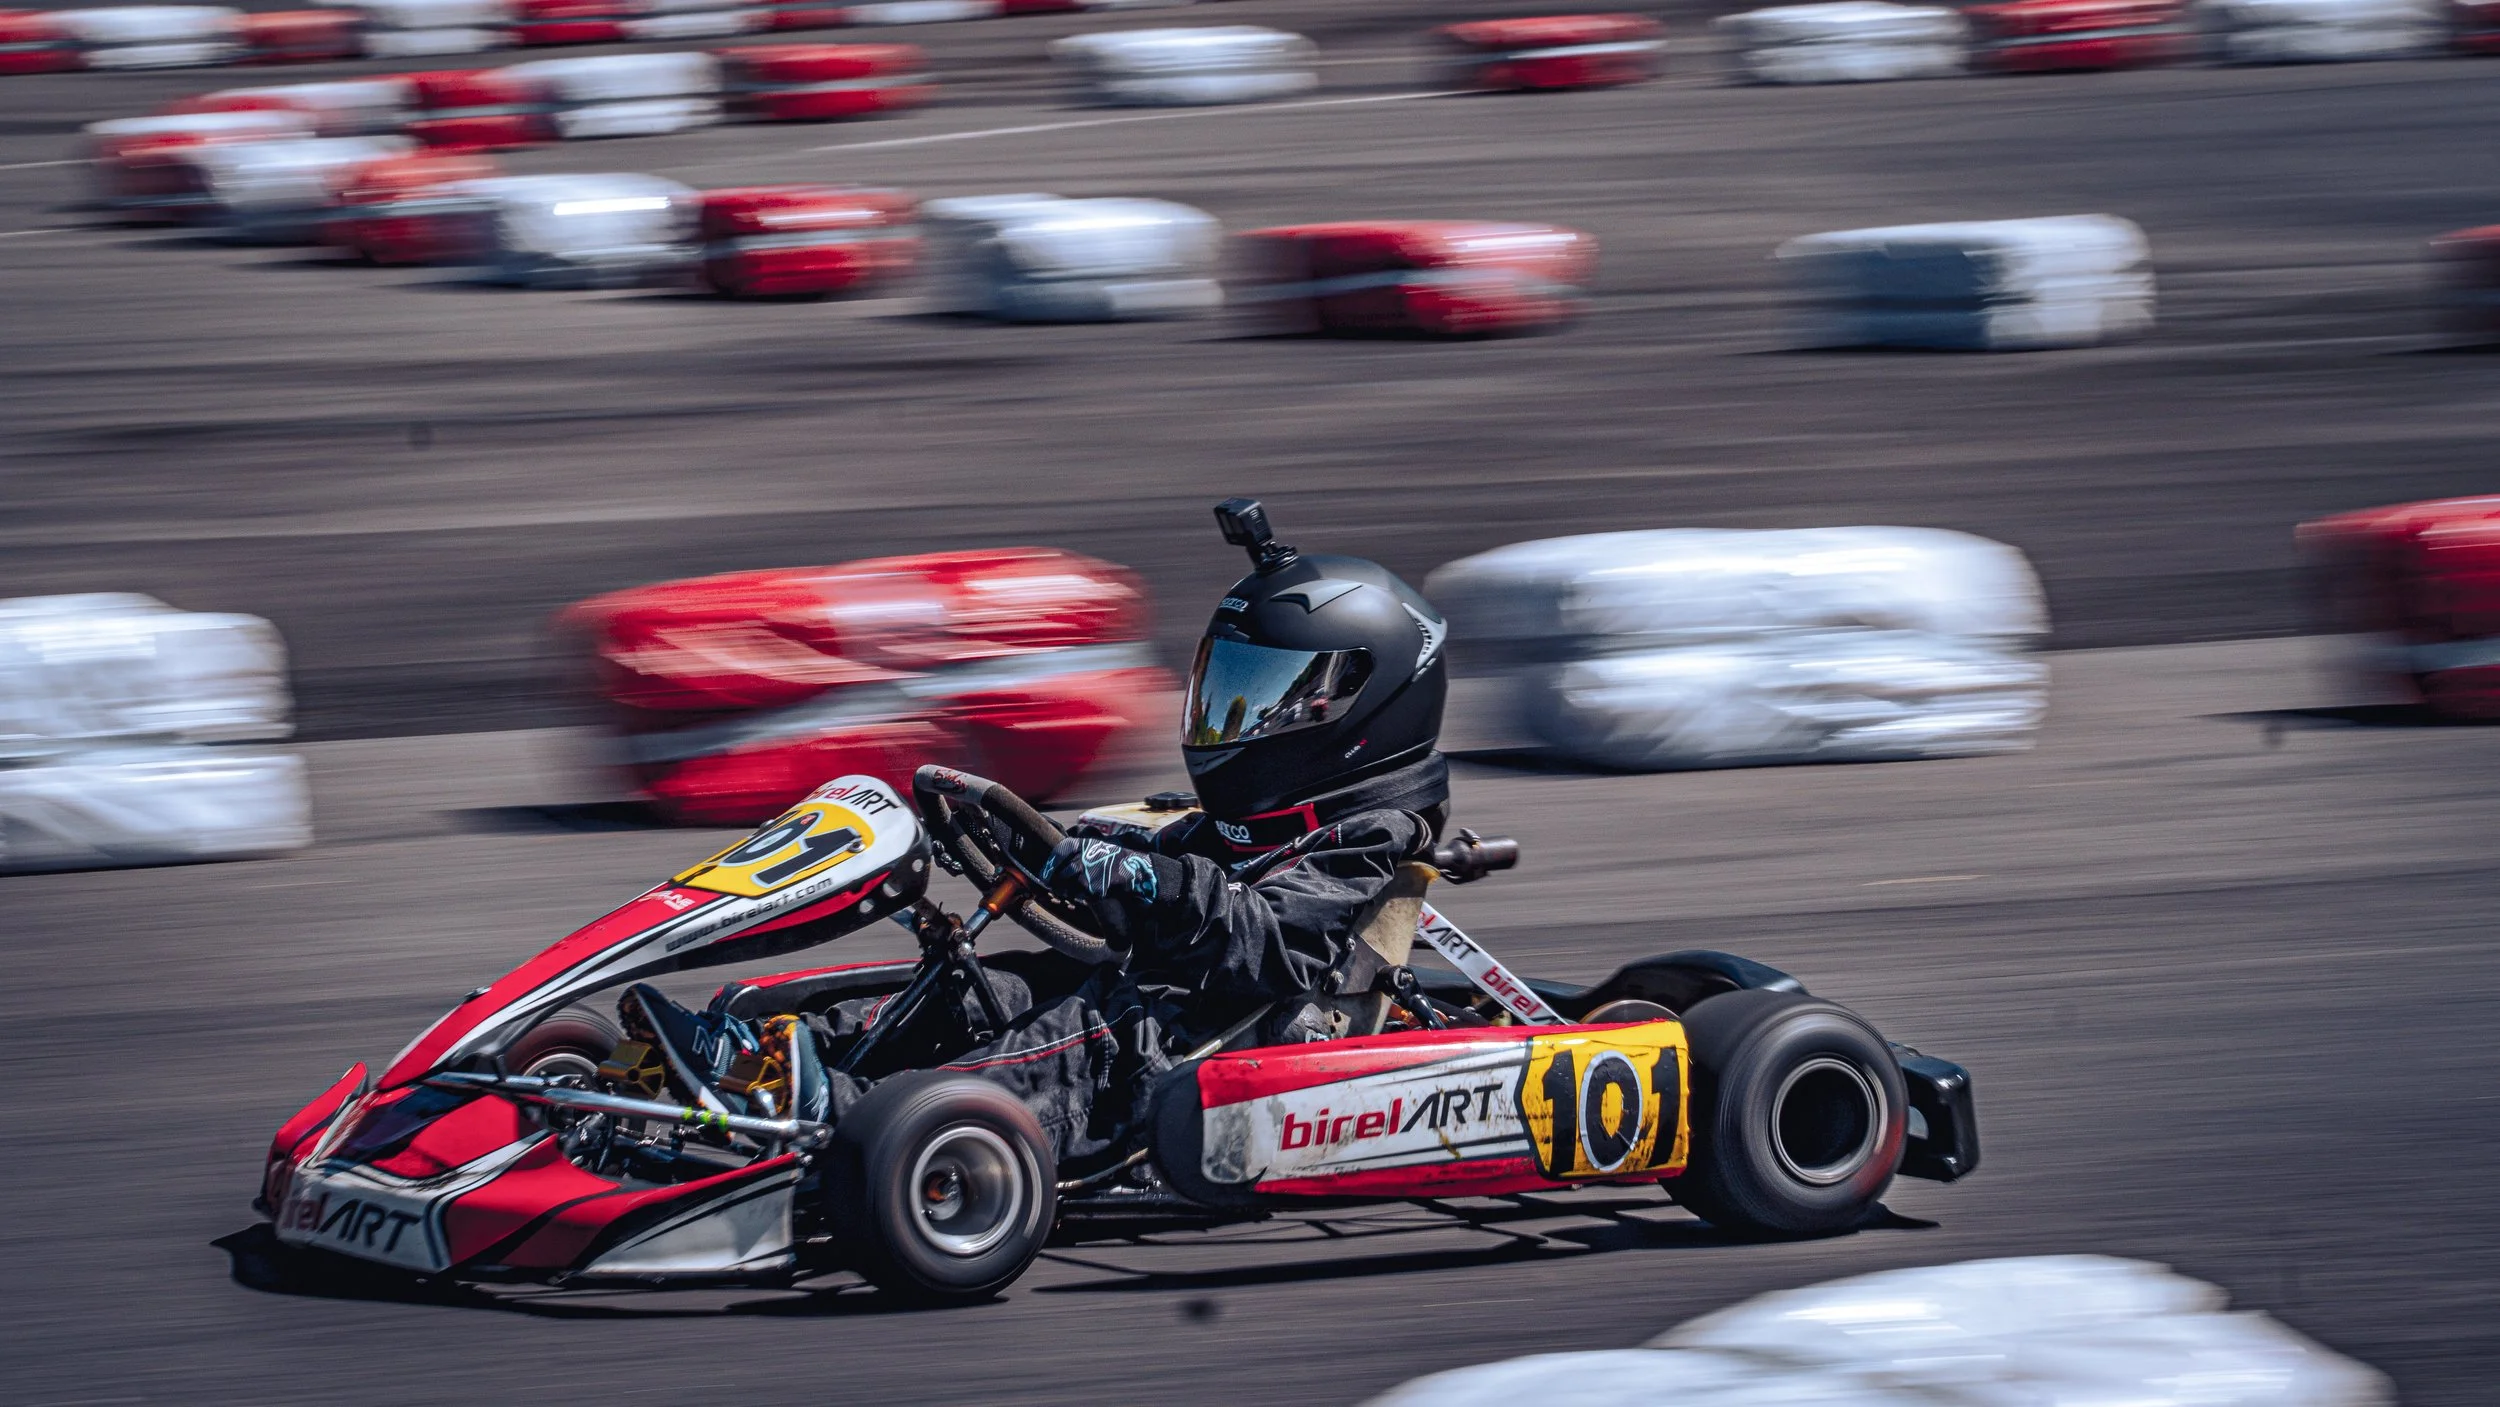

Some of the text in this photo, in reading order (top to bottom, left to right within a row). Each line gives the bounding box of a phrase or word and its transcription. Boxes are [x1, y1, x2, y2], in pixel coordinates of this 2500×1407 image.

[666, 877, 832, 952] www.birelart.com
[1480, 965, 1553, 1021] birel
[1279, 1082, 1503, 1152] birelART
[1541, 1045, 1681, 1174] 101
